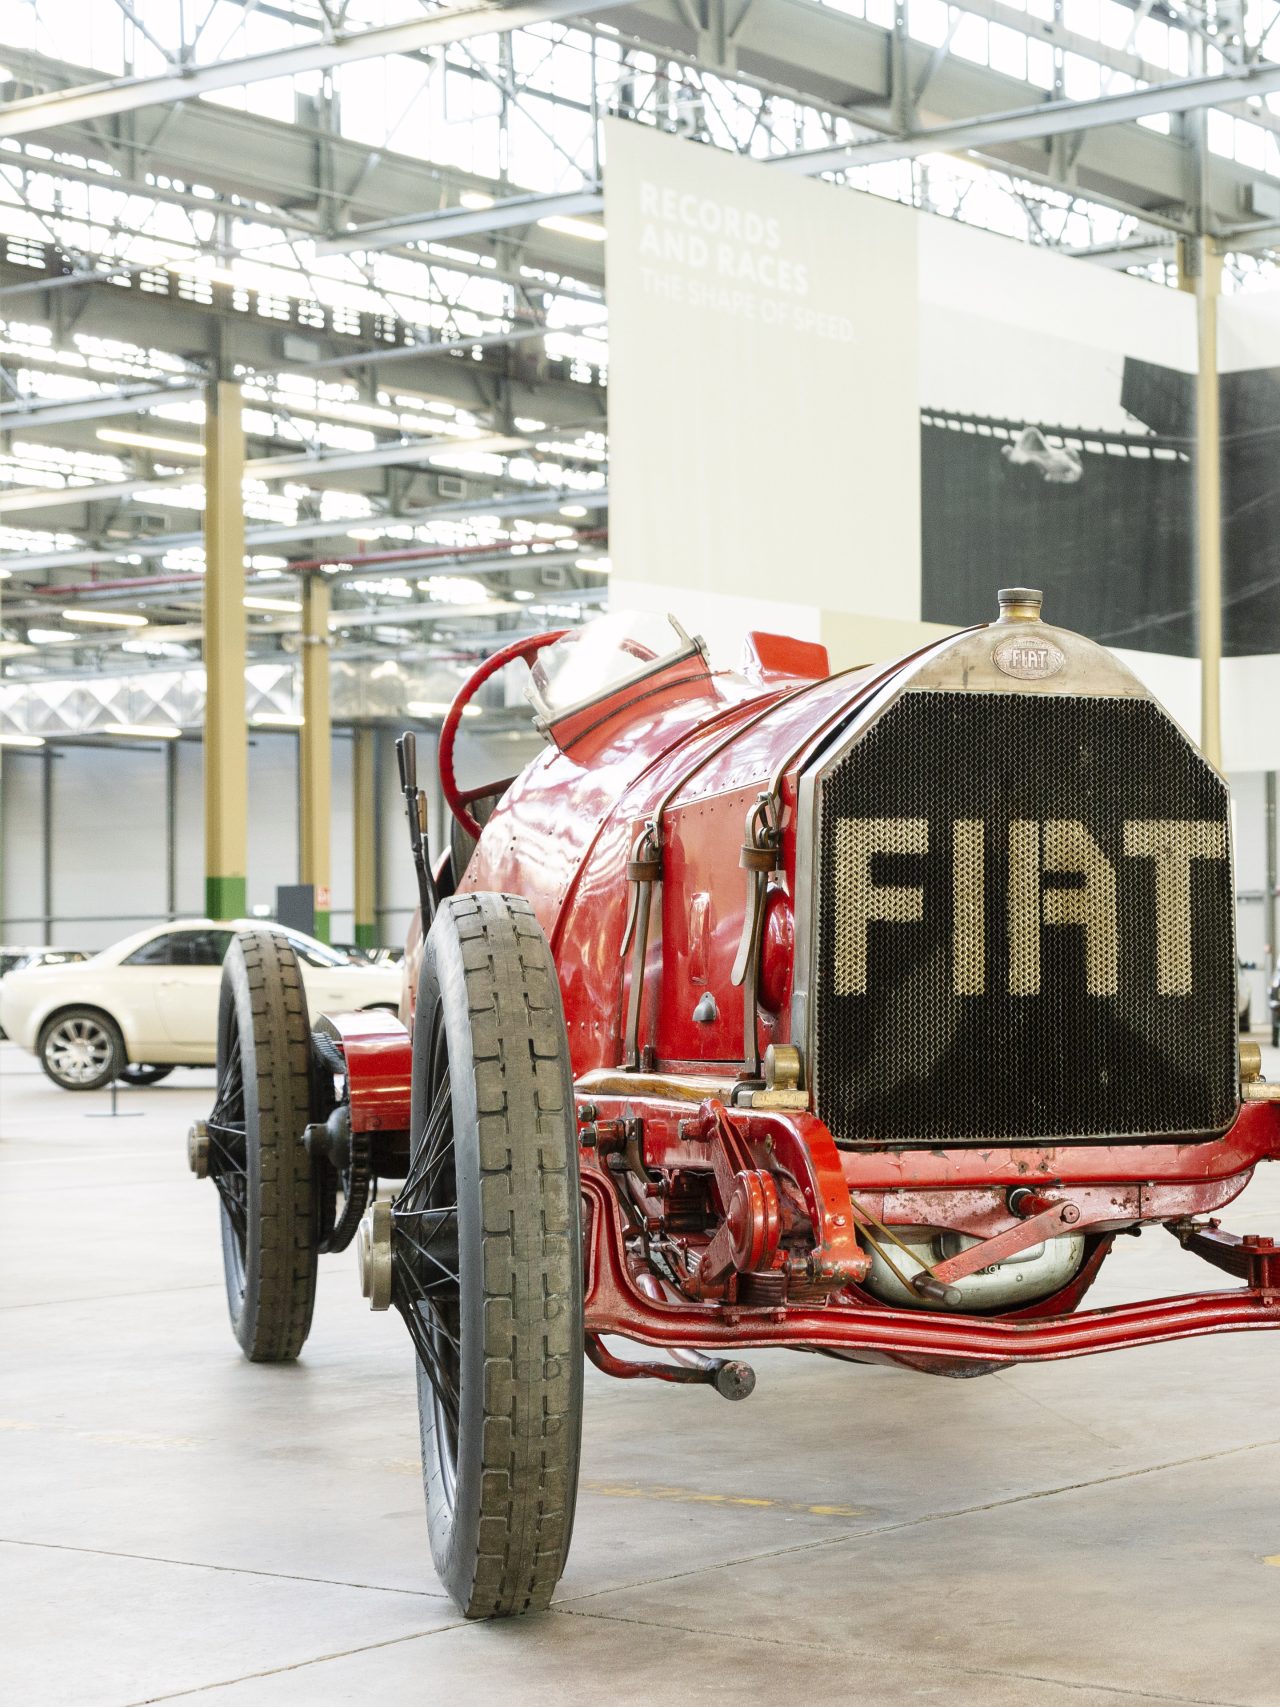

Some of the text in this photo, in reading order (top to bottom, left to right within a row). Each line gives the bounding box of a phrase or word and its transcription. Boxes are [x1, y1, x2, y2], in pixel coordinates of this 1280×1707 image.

[640, 179, 780, 250] RECORDS
[639, 223, 809, 297] AND RACES
[639, 267, 683, 302] THE
[688, 279, 756, 319] SHAPE
[760, 299, 789, 326] OF
[1012, 649, 1048, 668] FIAT
[834, 817, 1227, 996] FIAT
